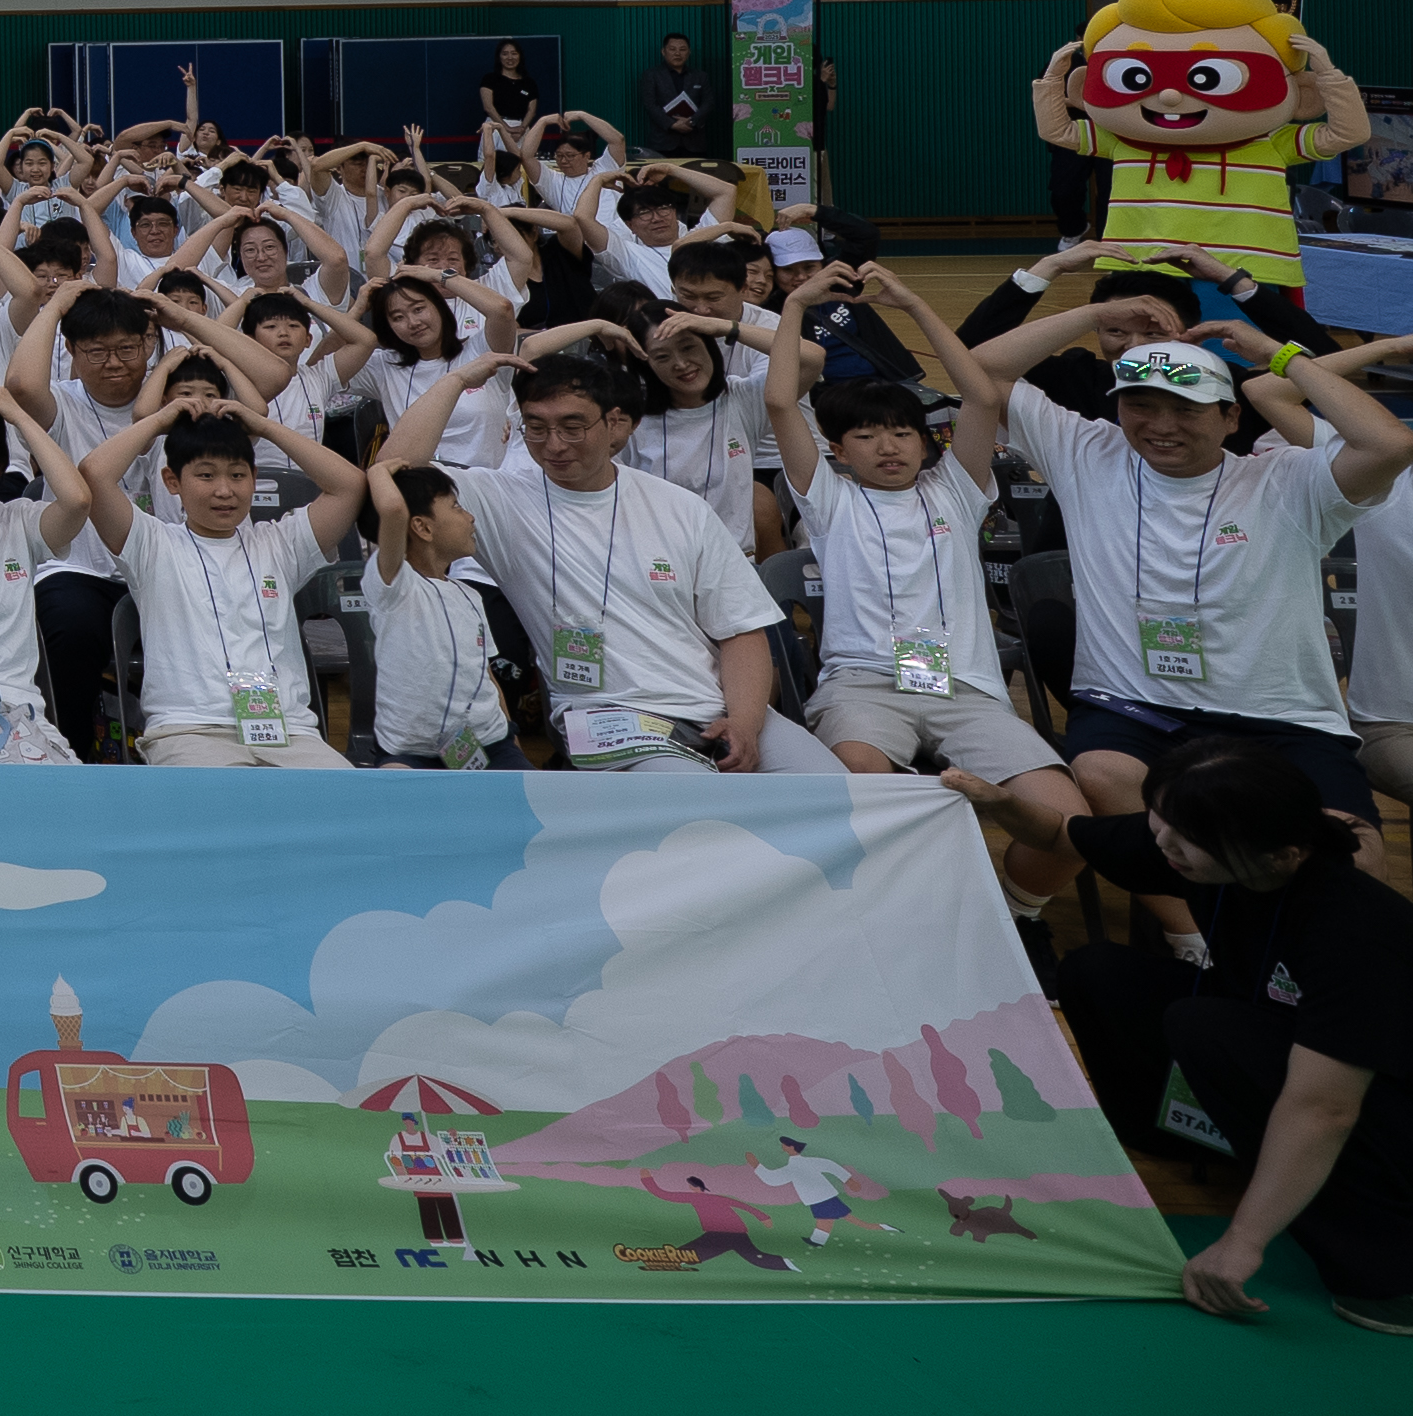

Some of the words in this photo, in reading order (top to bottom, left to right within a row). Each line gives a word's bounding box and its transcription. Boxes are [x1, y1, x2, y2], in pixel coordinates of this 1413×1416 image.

[752, 44, 793, 65] 게임
[1219, 524, 1239, 535] 게임
[652, 563, 671, 572] 게임
[346, 599, 361, 607] 3호
[1158, 655, 1170, 663] 1호
[1173, 656, 1189, 665] 가족
[565, 663, 576, 671] 3호
[578, 664, 590, 673] 가족
[7, 1245, 82, 1262] 신구대학교
[143, 1248, 219, 1263] 을지대학교
[327, 1247, 381, 1269] 협찬
[13, 1261, 46, 1270] SHINGU
[47, 1262, 84, 1271] COLLEGE
[173, 1263, 221, 1272] UNIVERSITY
